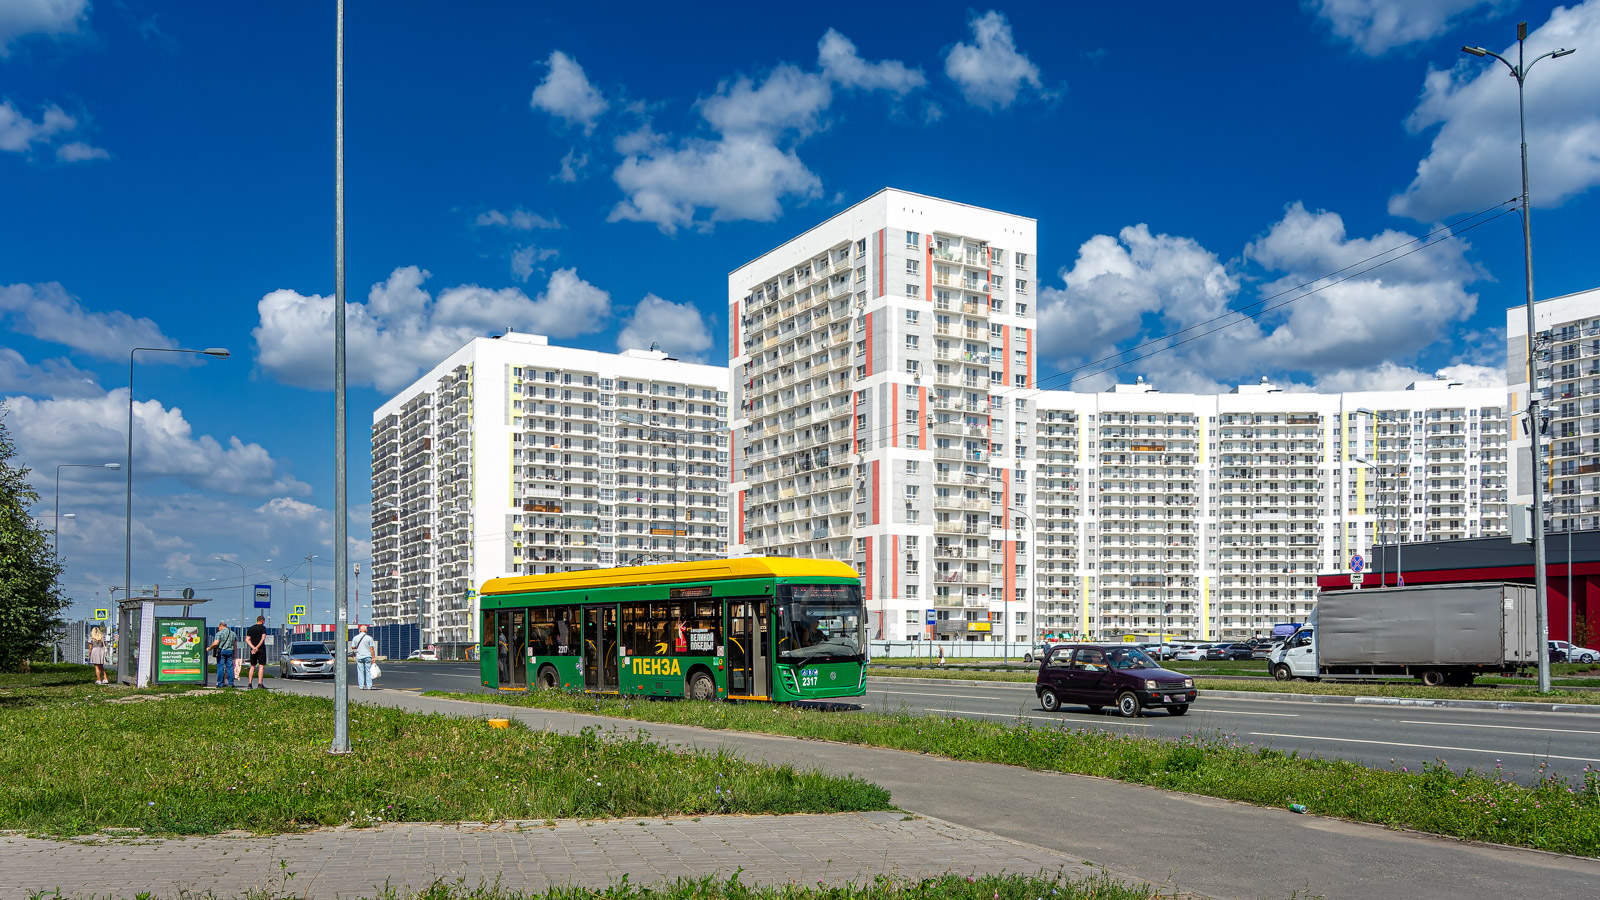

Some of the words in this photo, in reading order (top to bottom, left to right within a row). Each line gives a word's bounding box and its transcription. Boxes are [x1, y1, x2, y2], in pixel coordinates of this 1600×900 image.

[690, 632, 714, 641] ВЕЛИКОЙ
[690, 642, 714, 651] ПОБЕДЫ!
[633, 658, 681, 675] ПЕНЗА
[802, 677, 818, 686] 2317
